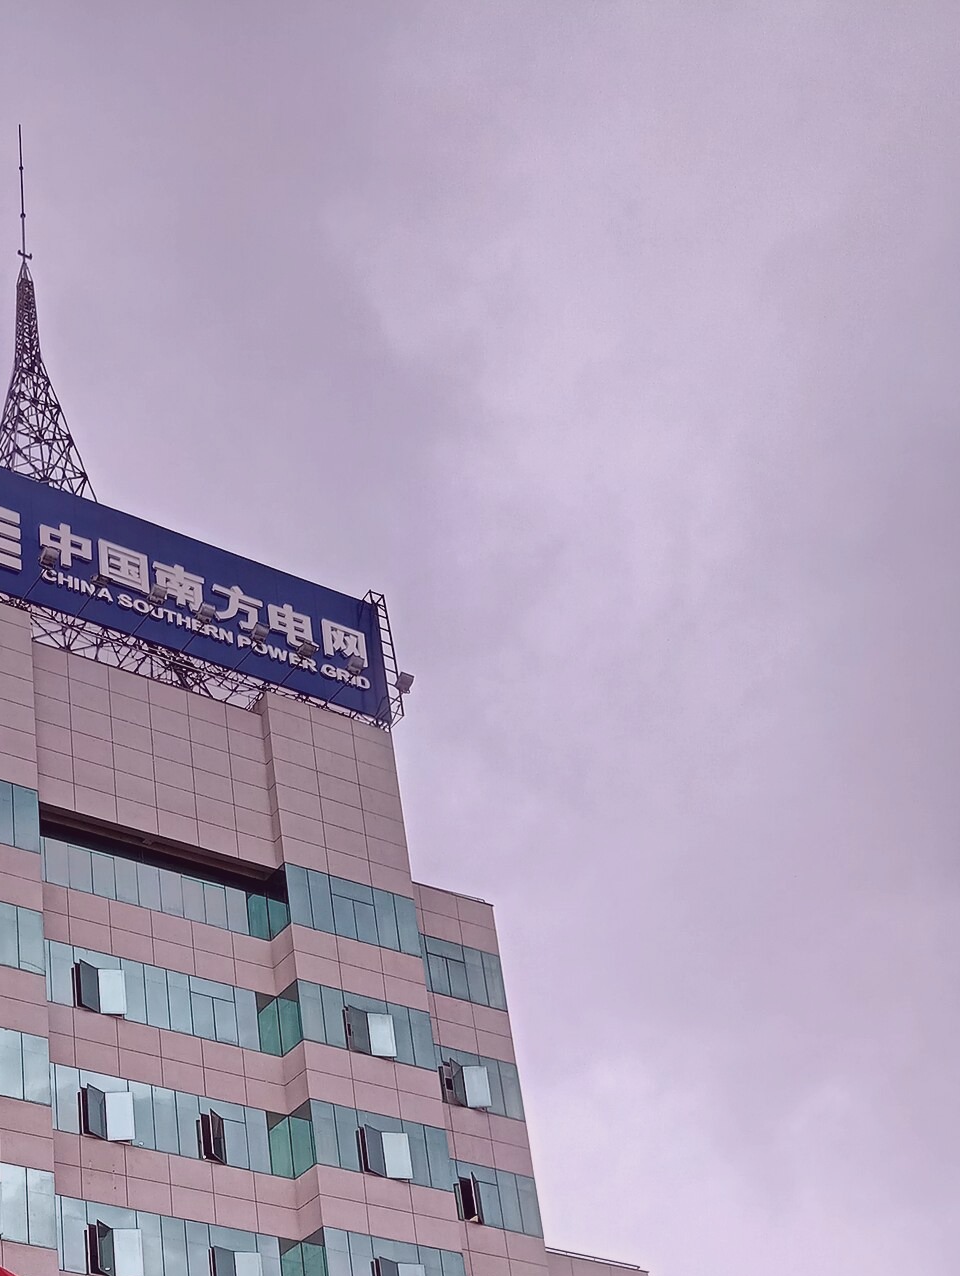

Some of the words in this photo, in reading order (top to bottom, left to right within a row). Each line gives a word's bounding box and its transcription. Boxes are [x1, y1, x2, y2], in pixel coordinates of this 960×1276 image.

[39, 522, 368, 668] 中国南方电网
[42, 568, 114, 603] CHINA
[118, 593, 233, 644] SOUTHERN
[237, 634, 318, 674] POWER
[320, 663, 371, 690] GRID
